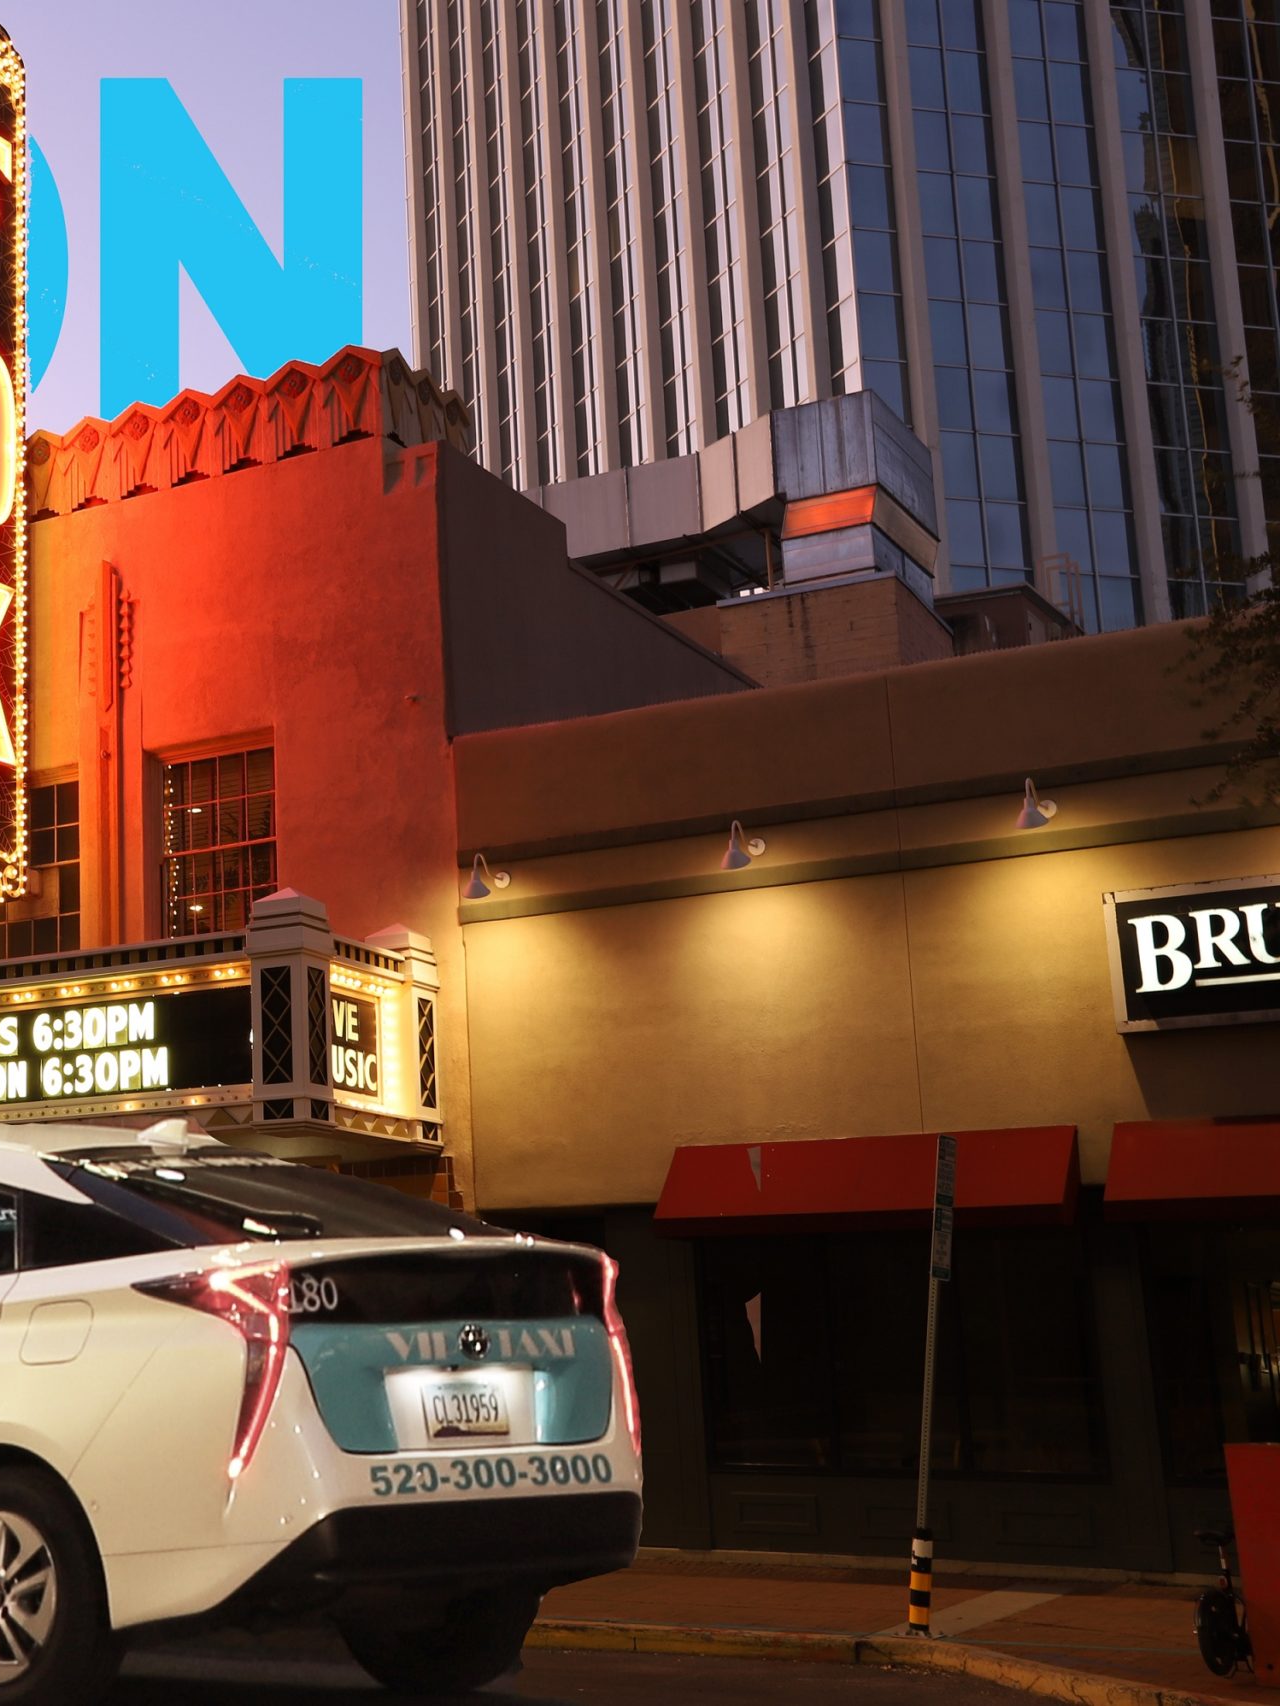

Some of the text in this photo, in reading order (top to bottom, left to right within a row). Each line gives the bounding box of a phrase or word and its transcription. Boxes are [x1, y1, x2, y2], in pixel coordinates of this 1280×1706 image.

[1127, 903, 1280, 993] BRU
[33, 1001, 155, 1051] 6:30PM
[42, 1046, 169, 1097] 6:30PM
[287, 1276, 338, 1314] 180
[498, 1327, 576, 1359] TAXI
[432, 1393, 499, 1425] CL31959
[370, 1453, 612, 1497] 520-300-3000
